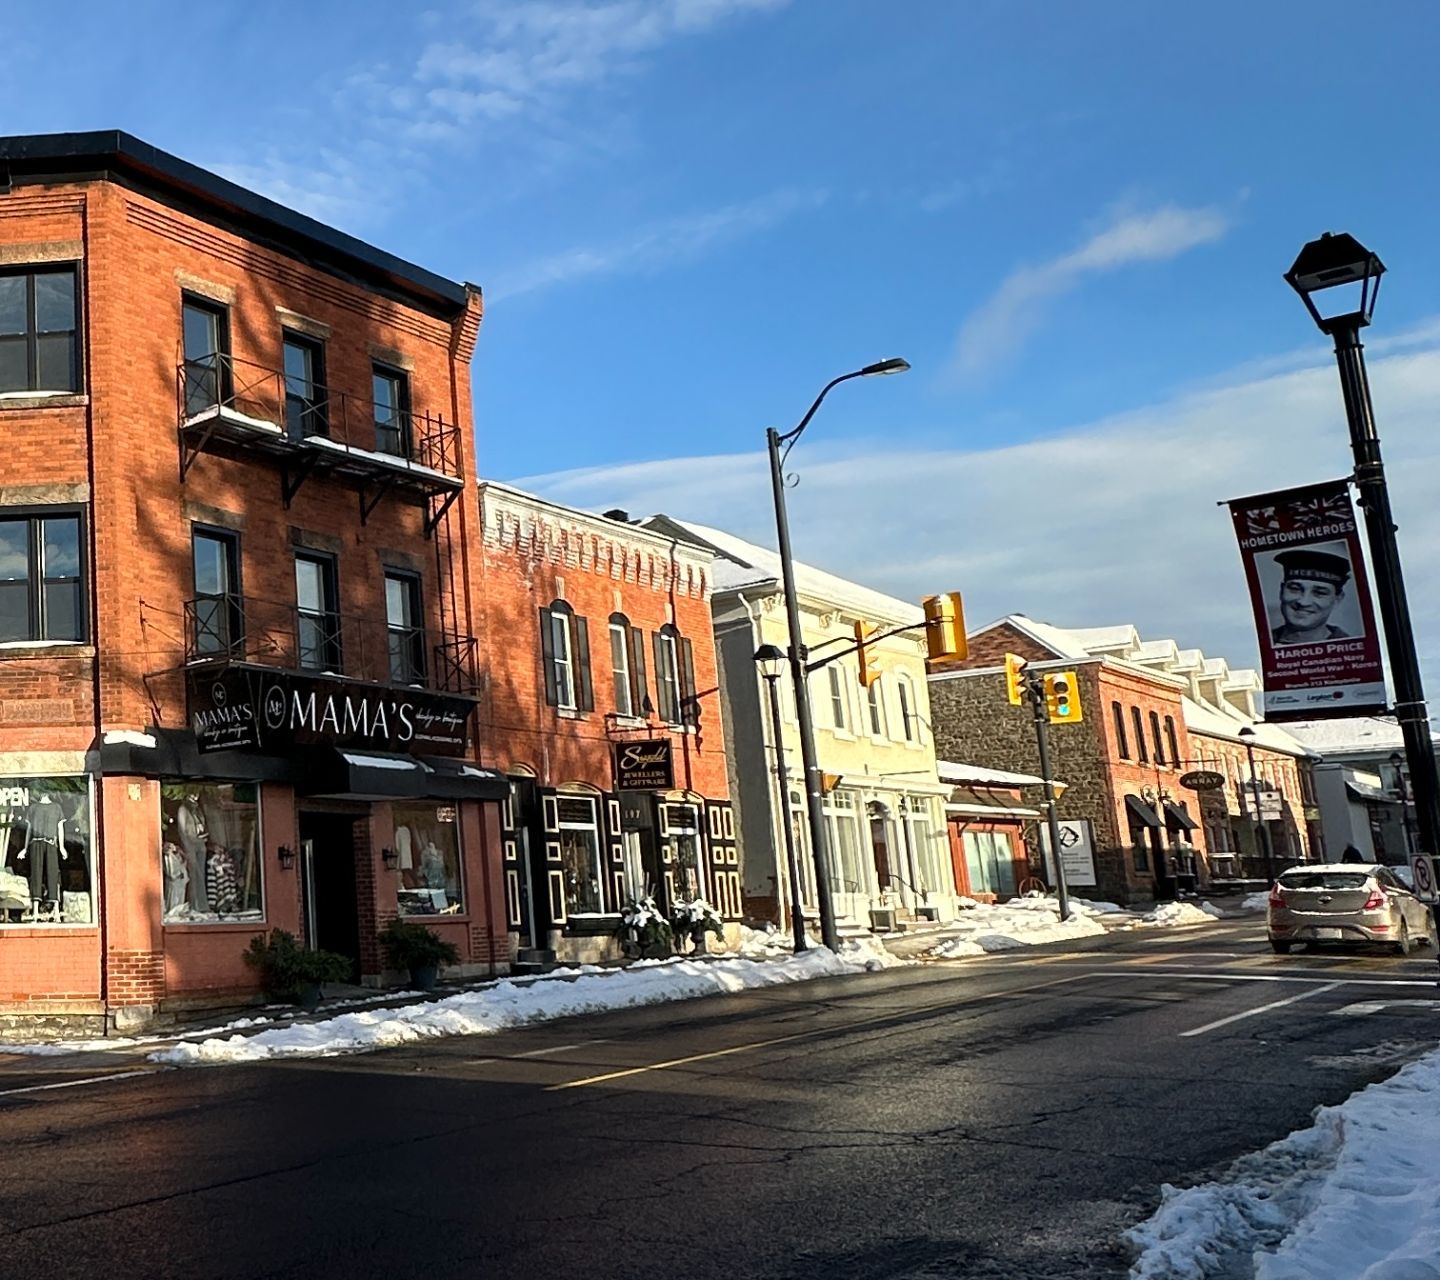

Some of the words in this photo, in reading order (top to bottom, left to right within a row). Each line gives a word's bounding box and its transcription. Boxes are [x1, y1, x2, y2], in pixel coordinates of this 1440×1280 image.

[1241, 530, 1305, 549] HOMETOWN
[1307, 521, 1355, 537] HEROES
[1275, 646, 1324, 660] HAROLD
[1326, 642, 1365, 654] PRICE
[1267, 668, 1299, 678] Second
[1300, 666, 1326, 675] World
[1327, 664, 1345, 673] War
[1351, 661, 1378, 670] Korea
[1276, 661, 1301, 670] Royal
[1301, 657, 1343, 667] Canadian
[1343, 655, 1365, 663] Navy
[194, 703, 253, 726] MAMA'S
[289, 689, 414, 741] MAMA'S
[1185, 777, 1218, 785] ARRAY
